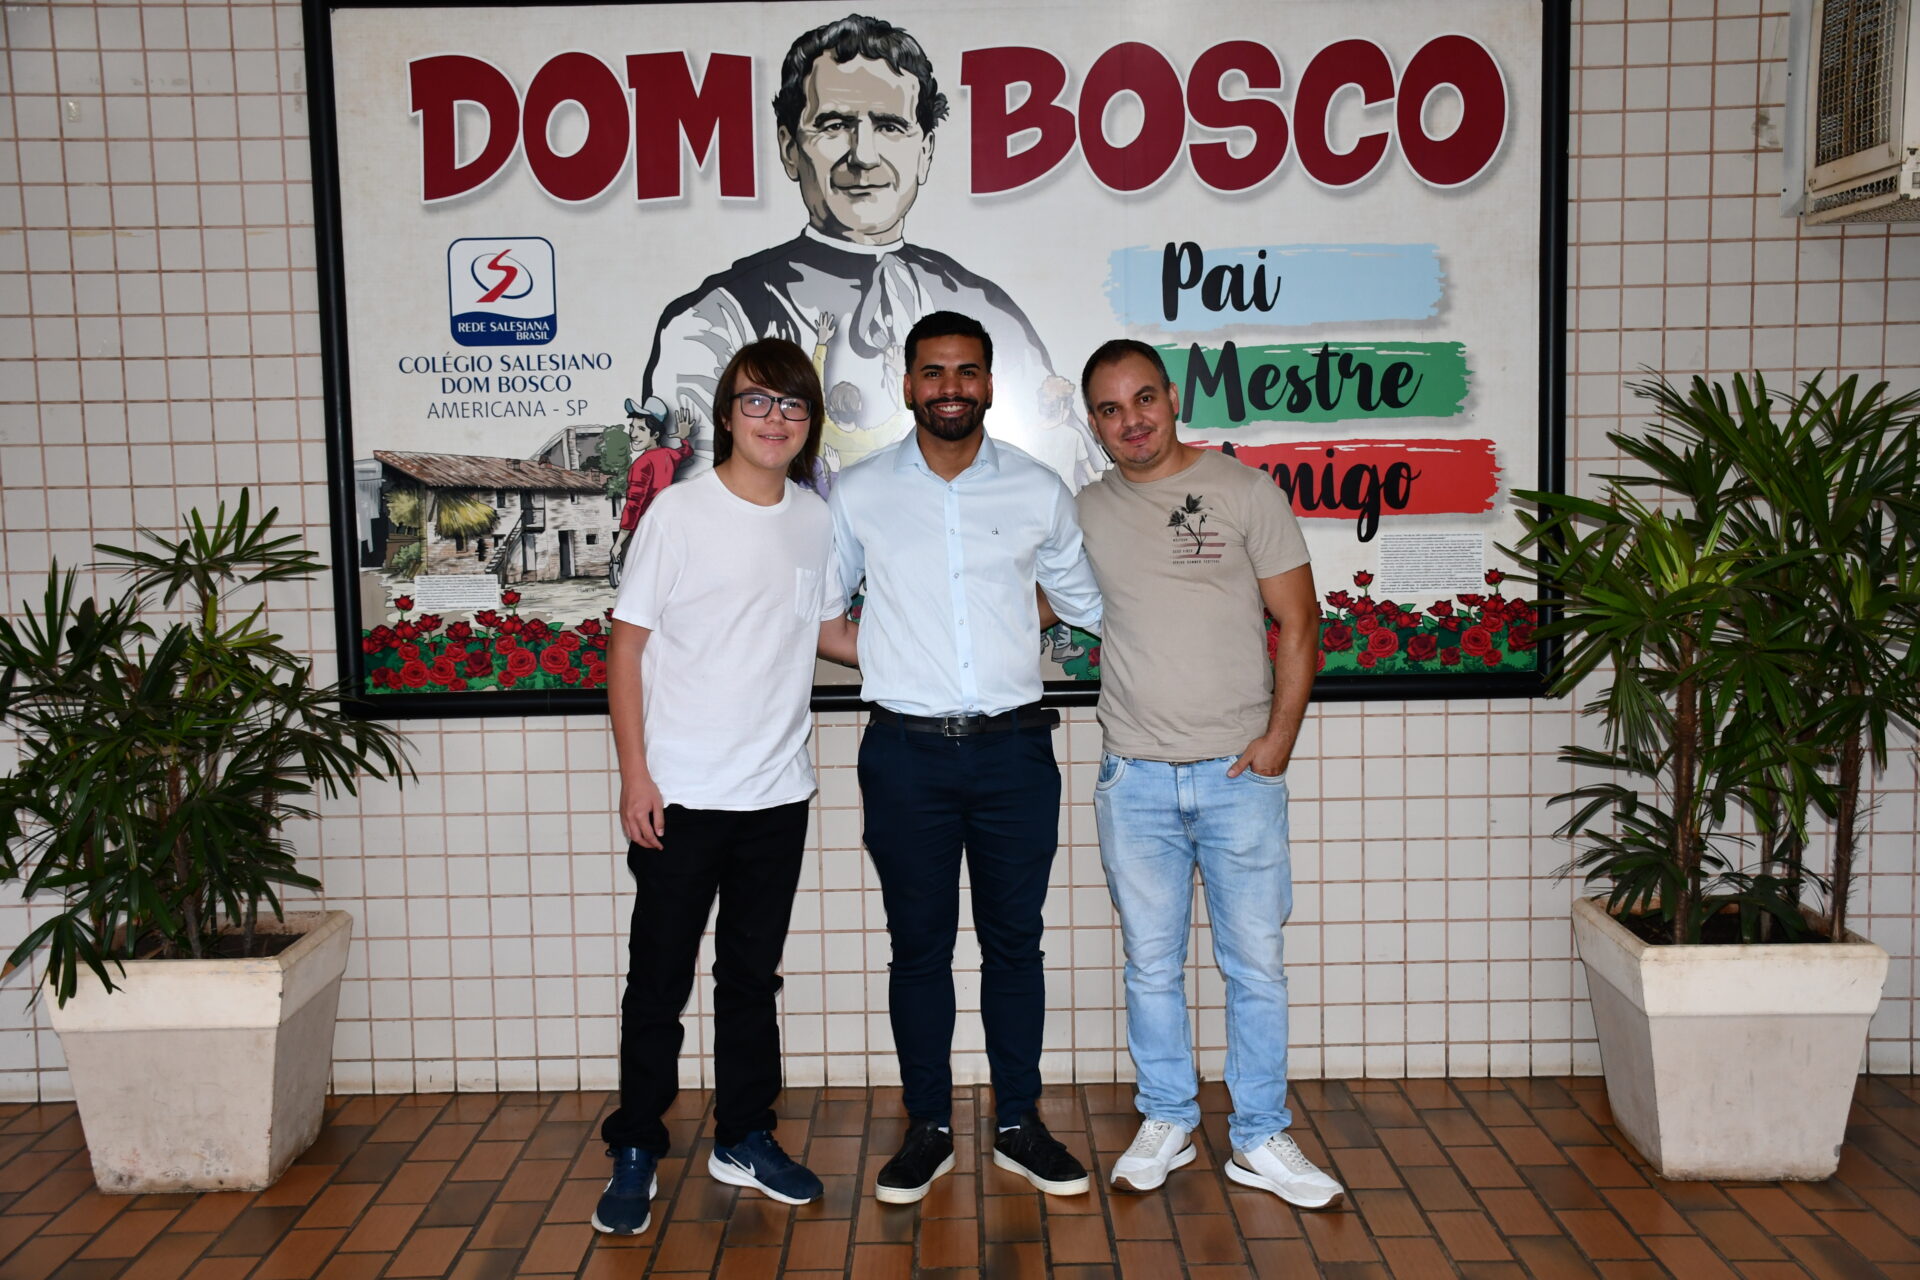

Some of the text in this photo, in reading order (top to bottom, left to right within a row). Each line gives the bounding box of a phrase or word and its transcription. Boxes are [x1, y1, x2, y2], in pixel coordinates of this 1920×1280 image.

[411, 35, 1507, 200] DOM BOSCO
[1162, 241, 1282, 321] Pai
[457, 321, 550, 333] REDE SALESIANA
[516, 331, 549, 341] BRASIL
[398, 351, 613, 374] COLÉGIO SALESIANO
[441, 374, 572, 394] DOM BOSCO
[1182, 341, 1424, 423] Mestre
[426, 400, 546, 419] AMERICANA
[566, 399, 588, 416] SP
[1222, 441, 1422, 542] migo
